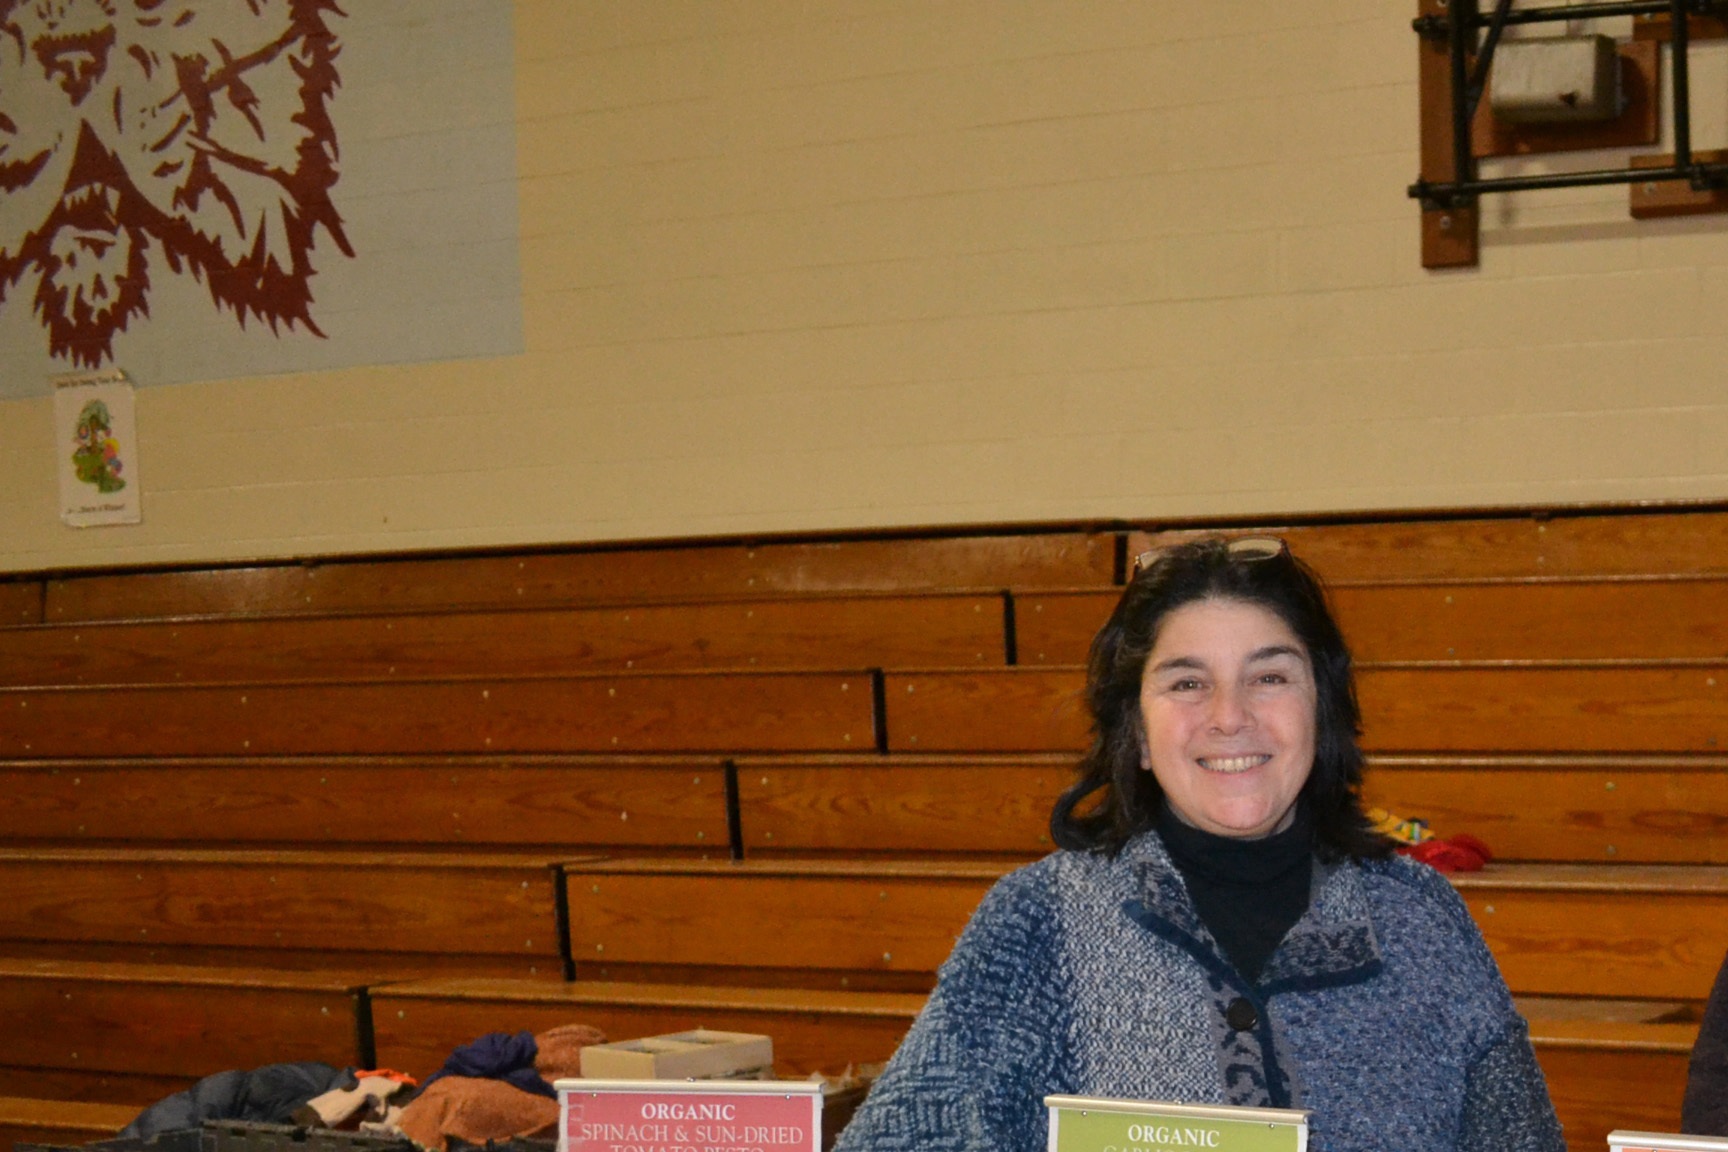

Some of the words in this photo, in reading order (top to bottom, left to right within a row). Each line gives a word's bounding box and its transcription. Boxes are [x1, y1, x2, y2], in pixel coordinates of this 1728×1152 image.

[641, 1103, 735, 1120] ORGANIC
[582, 1123, 668, 1142] SPINACH
[674, 1126, 689, 1142] &
[696, 1127, 803, 1144] SUN-DRIED
[1128, 1124, 1220, 1147] ORGANIC
